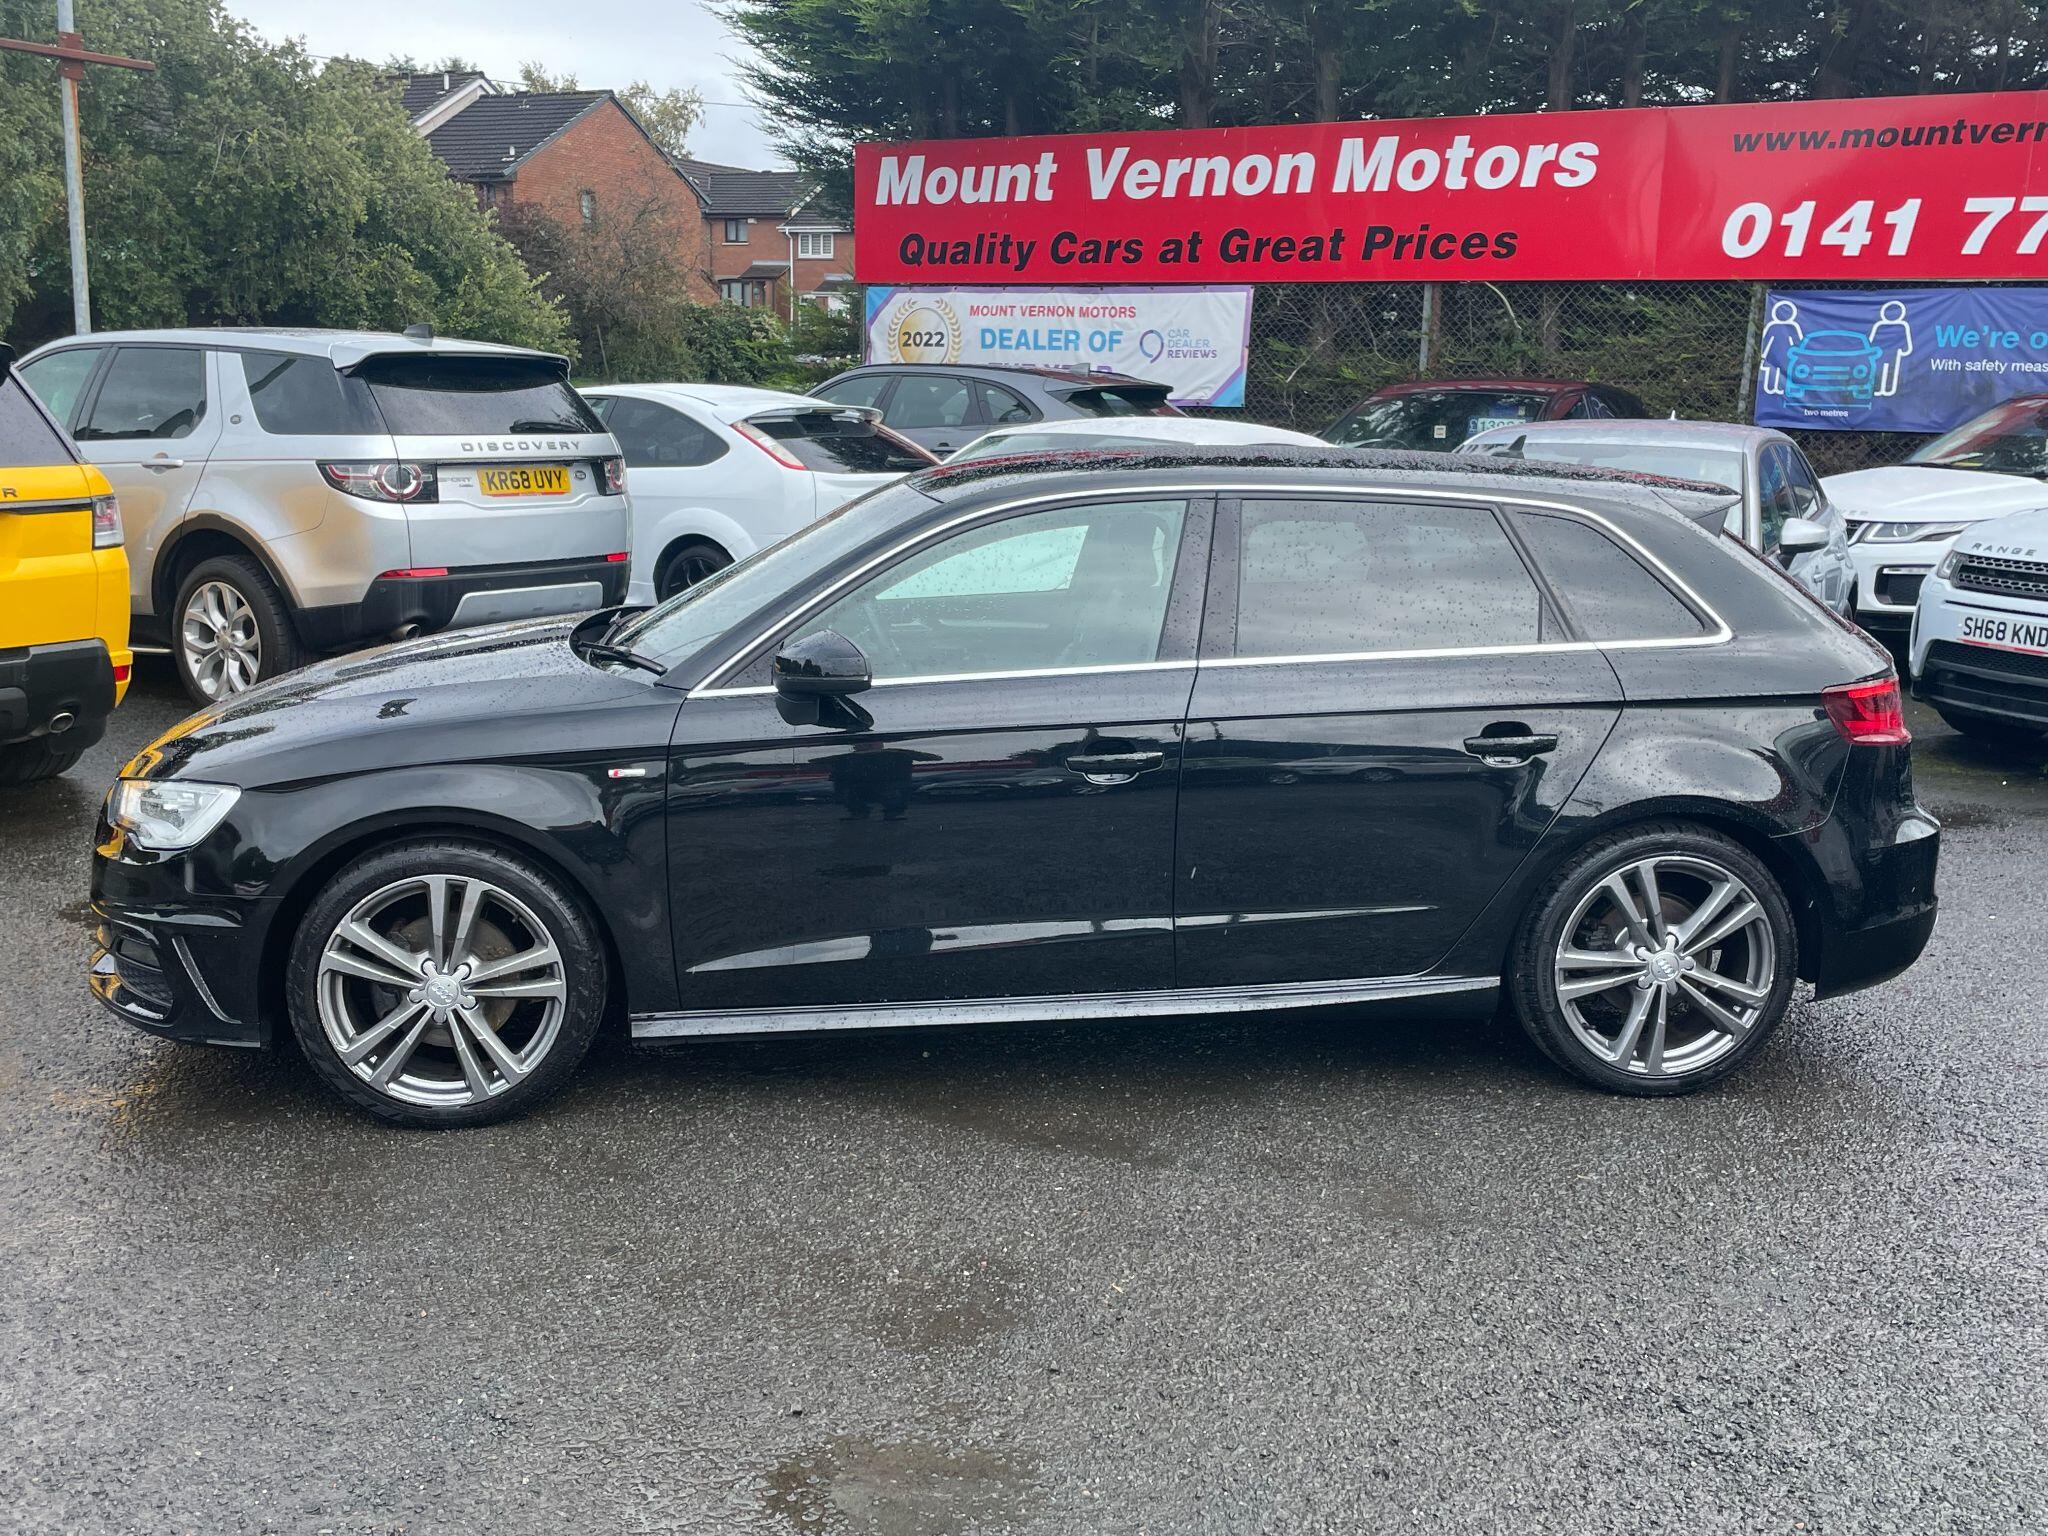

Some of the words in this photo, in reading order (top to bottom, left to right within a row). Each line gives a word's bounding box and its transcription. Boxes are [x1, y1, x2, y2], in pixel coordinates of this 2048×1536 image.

[875, 152, 1058, 206] Mount
[1087, 146, 1315, 200] Vernon
[1332, 135, 1600, 194] Motors
[1721, 199, 1922, 259] 0141
[1960, 196, 2048, 255] 77
[900, 233, 1036, 271] Quality
[1049, 231, 1144, 265] Cars
[1159, 230, 1203, 263] at
[1219, 227, 1345, 263] Great
[1362, 224, 1518, 261] Prices
[969, 305, 1016, 317] MOUNT
[1020, 305, 1076, 318] VERNON
[1079, 306, 1137, 319] MOTORS
[902, 331, 945, 348] 2022
[980, 328, 1080, 351] DEALER
[1089, 330, 1123, 352] OF
[1168, 329, 1190, 339] CAR
[1168, 339, 1210, 349] DEALER
[1168, 349, 1217, 359] REVIEWS
[1930, 358, 1961, 371] With
[1965, 359, 2008, 374] safety
[2011, 362, 2048, 373] meas
[1804, 409, 1819, 417] two
[1821, 409, 1849, 418] metres
[461, 440, 582, 452] DISCOVERY
[486, 468, 531, 491] KR68
[536, 467, 564, 488] UVY
[1971, 543, 2037, 557] RANGE
[1963, 617, 2007, 641] SH68
[2010, 623, 2048, 647] KND
